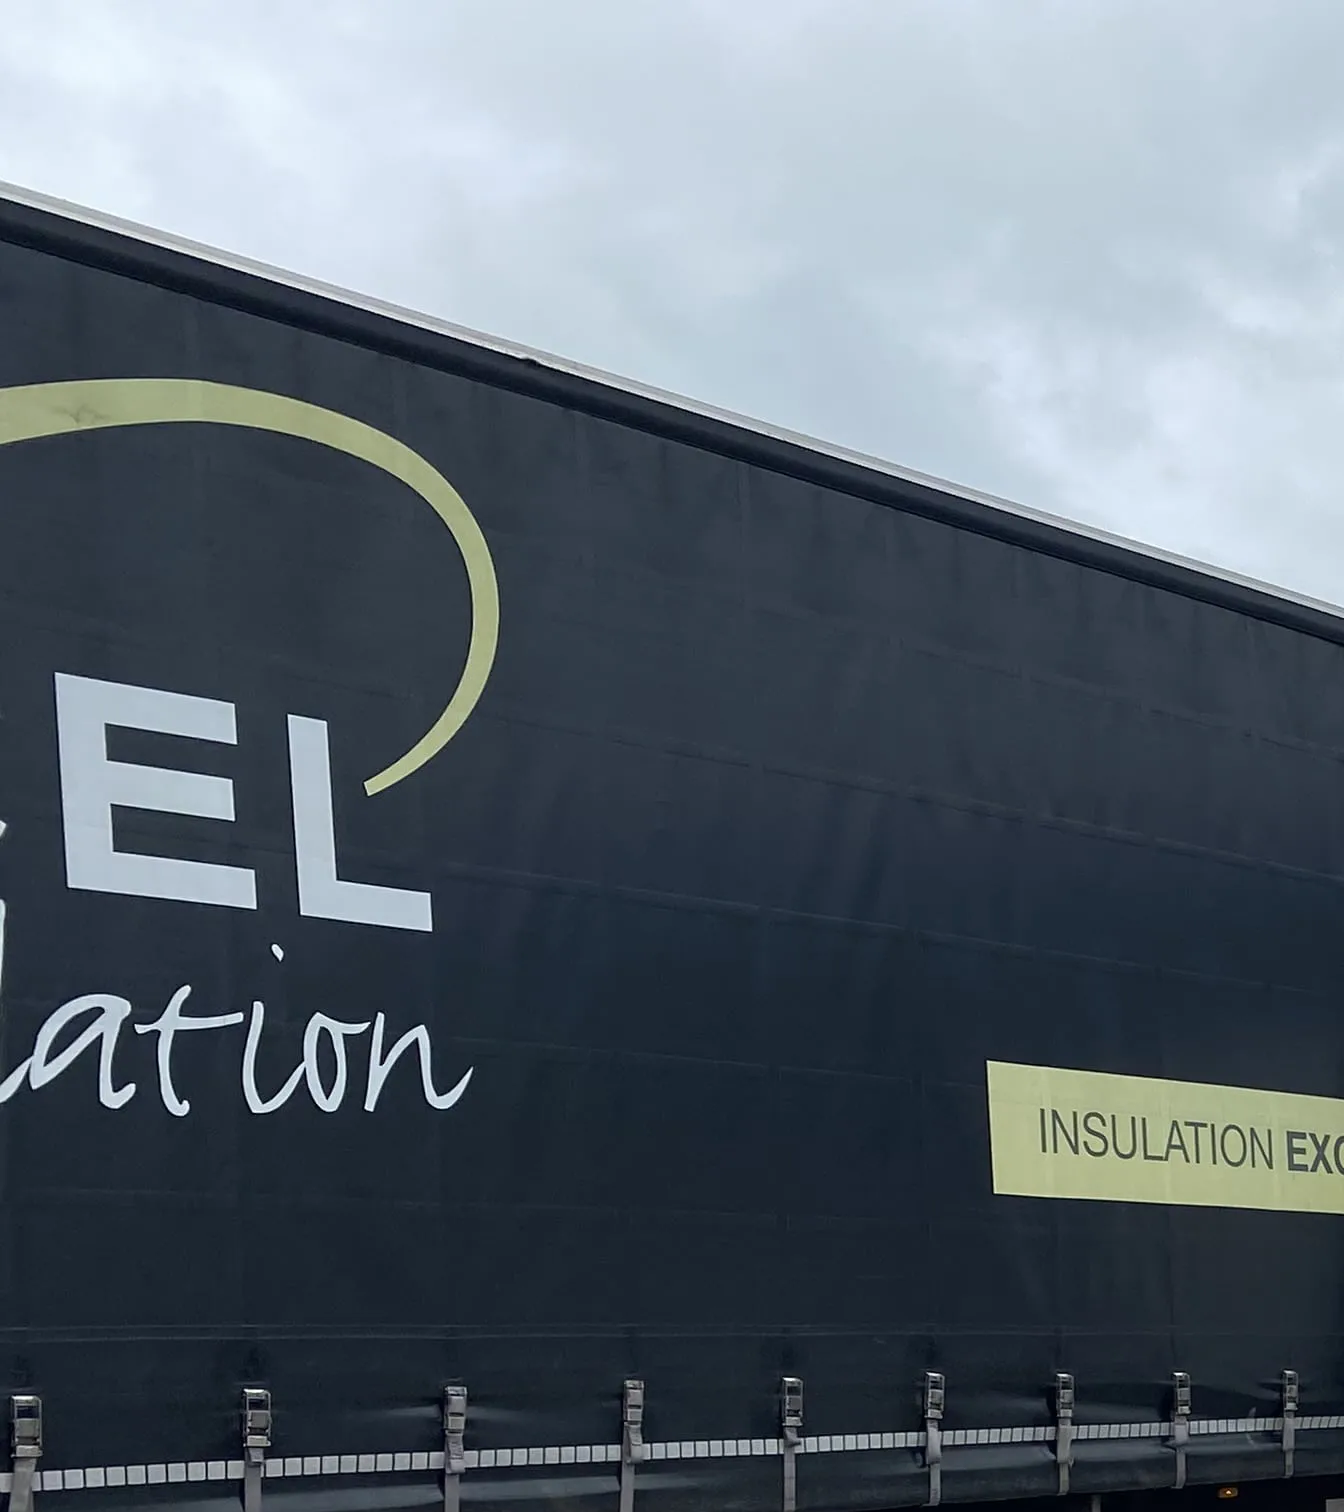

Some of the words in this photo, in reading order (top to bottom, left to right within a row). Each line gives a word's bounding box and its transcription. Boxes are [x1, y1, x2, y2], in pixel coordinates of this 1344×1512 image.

[0, 672, 433, 932] EL
[0, 900, 474, 1117] ation
[1038, 1107, 1274, 1170] INSULATION
